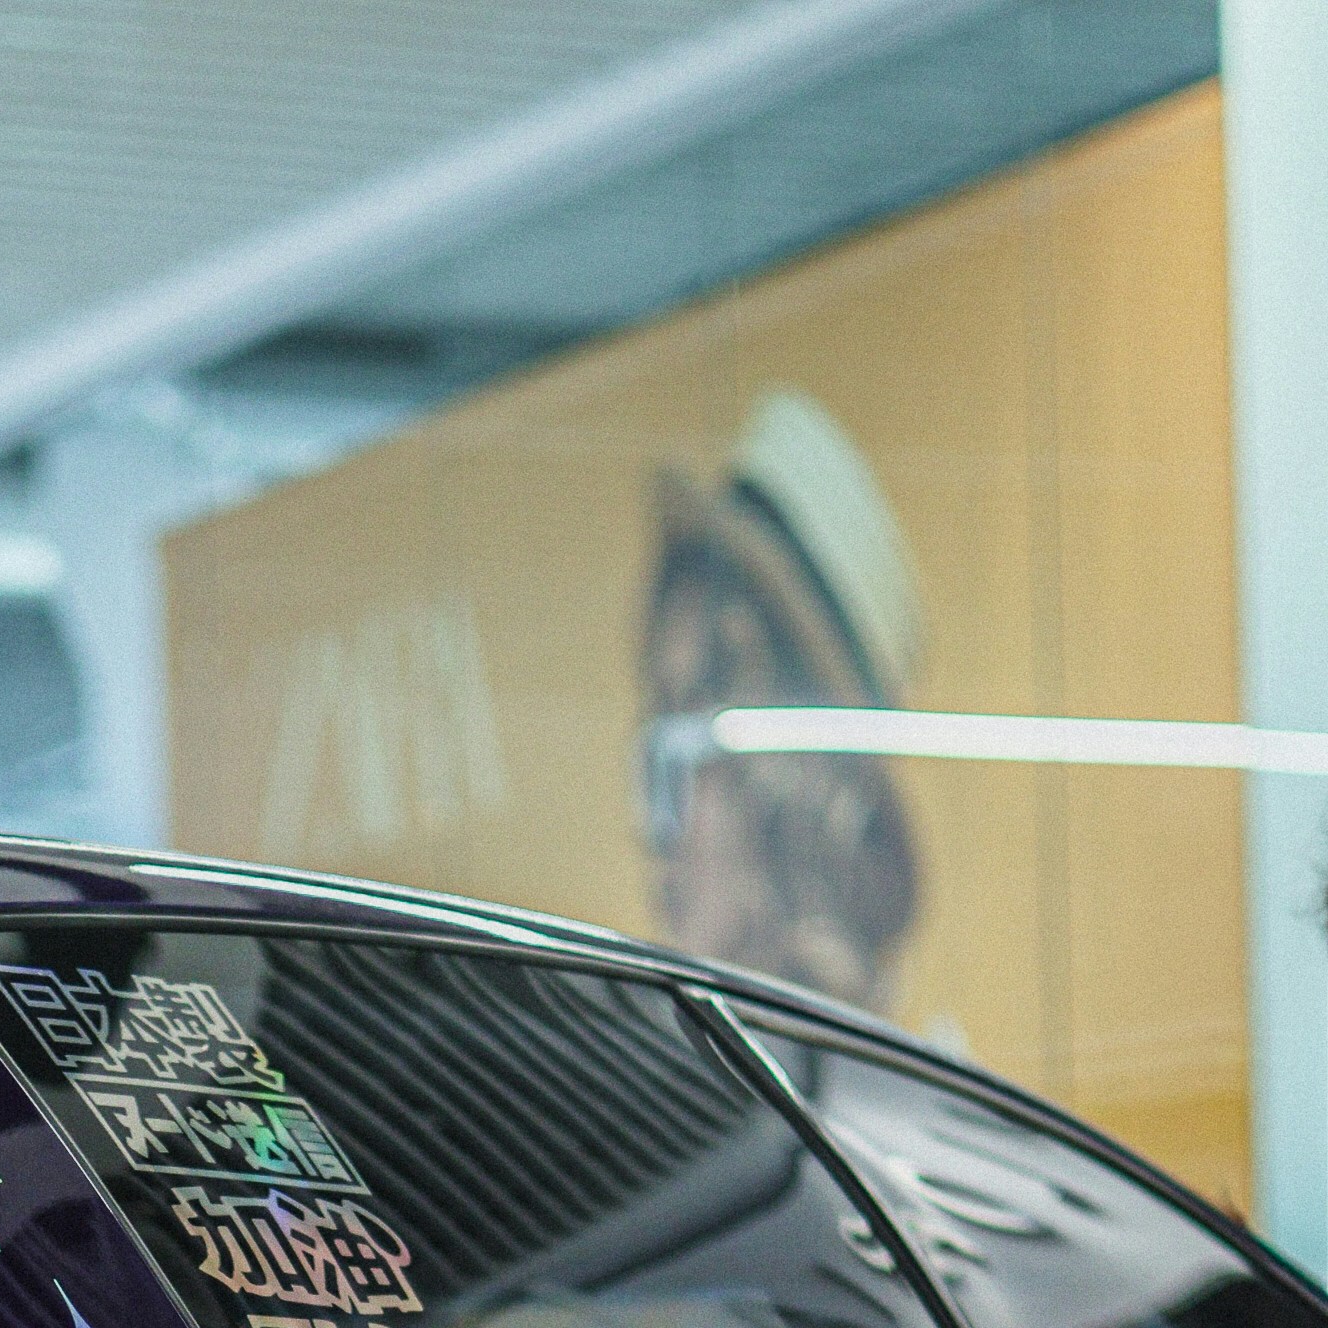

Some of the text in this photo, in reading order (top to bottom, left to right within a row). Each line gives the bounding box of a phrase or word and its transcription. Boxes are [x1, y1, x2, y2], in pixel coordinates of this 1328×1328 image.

[88, 1091, 352, 1181] ヌード送信
[172, 1185, 424, 1315] 加油
